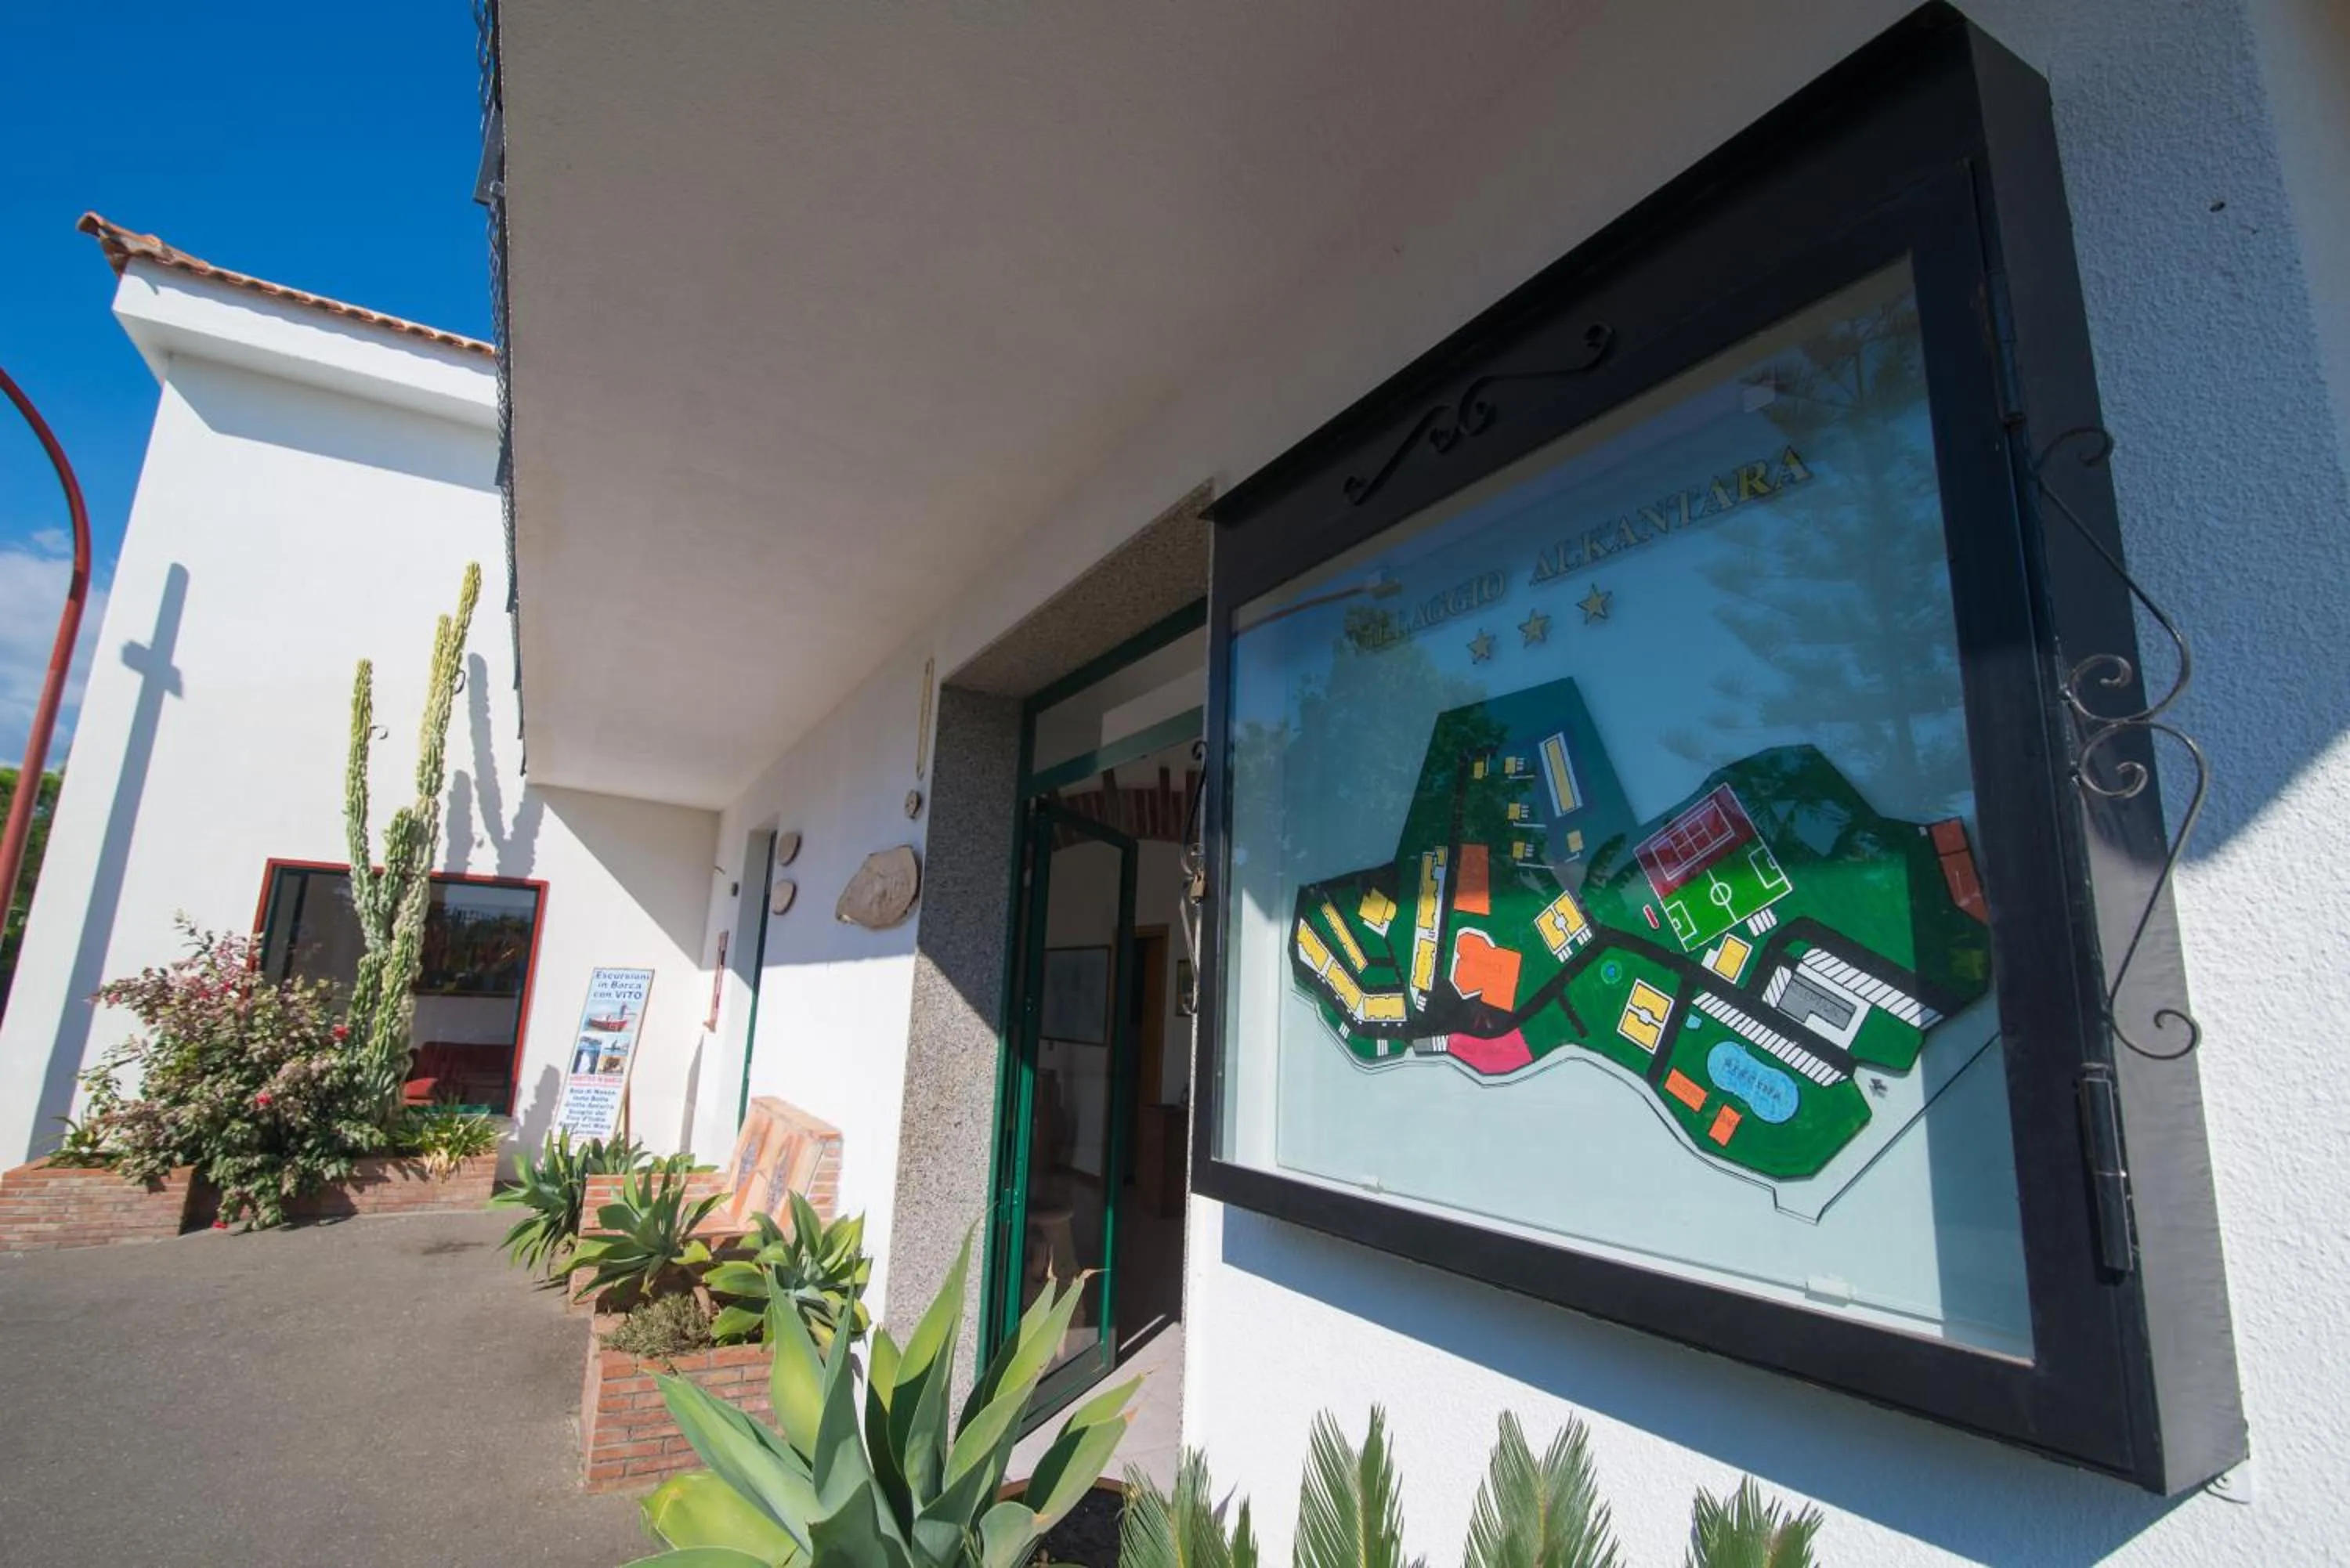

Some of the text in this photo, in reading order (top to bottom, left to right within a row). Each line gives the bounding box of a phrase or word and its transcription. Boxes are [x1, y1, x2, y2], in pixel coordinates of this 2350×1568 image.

[1528, 443, 1814, 587] ALKANTARA
[596, 971, 649, 980] Escursioni
[611, 981, 641, 989] Barca
[616, 990, 642, 999] VITO
